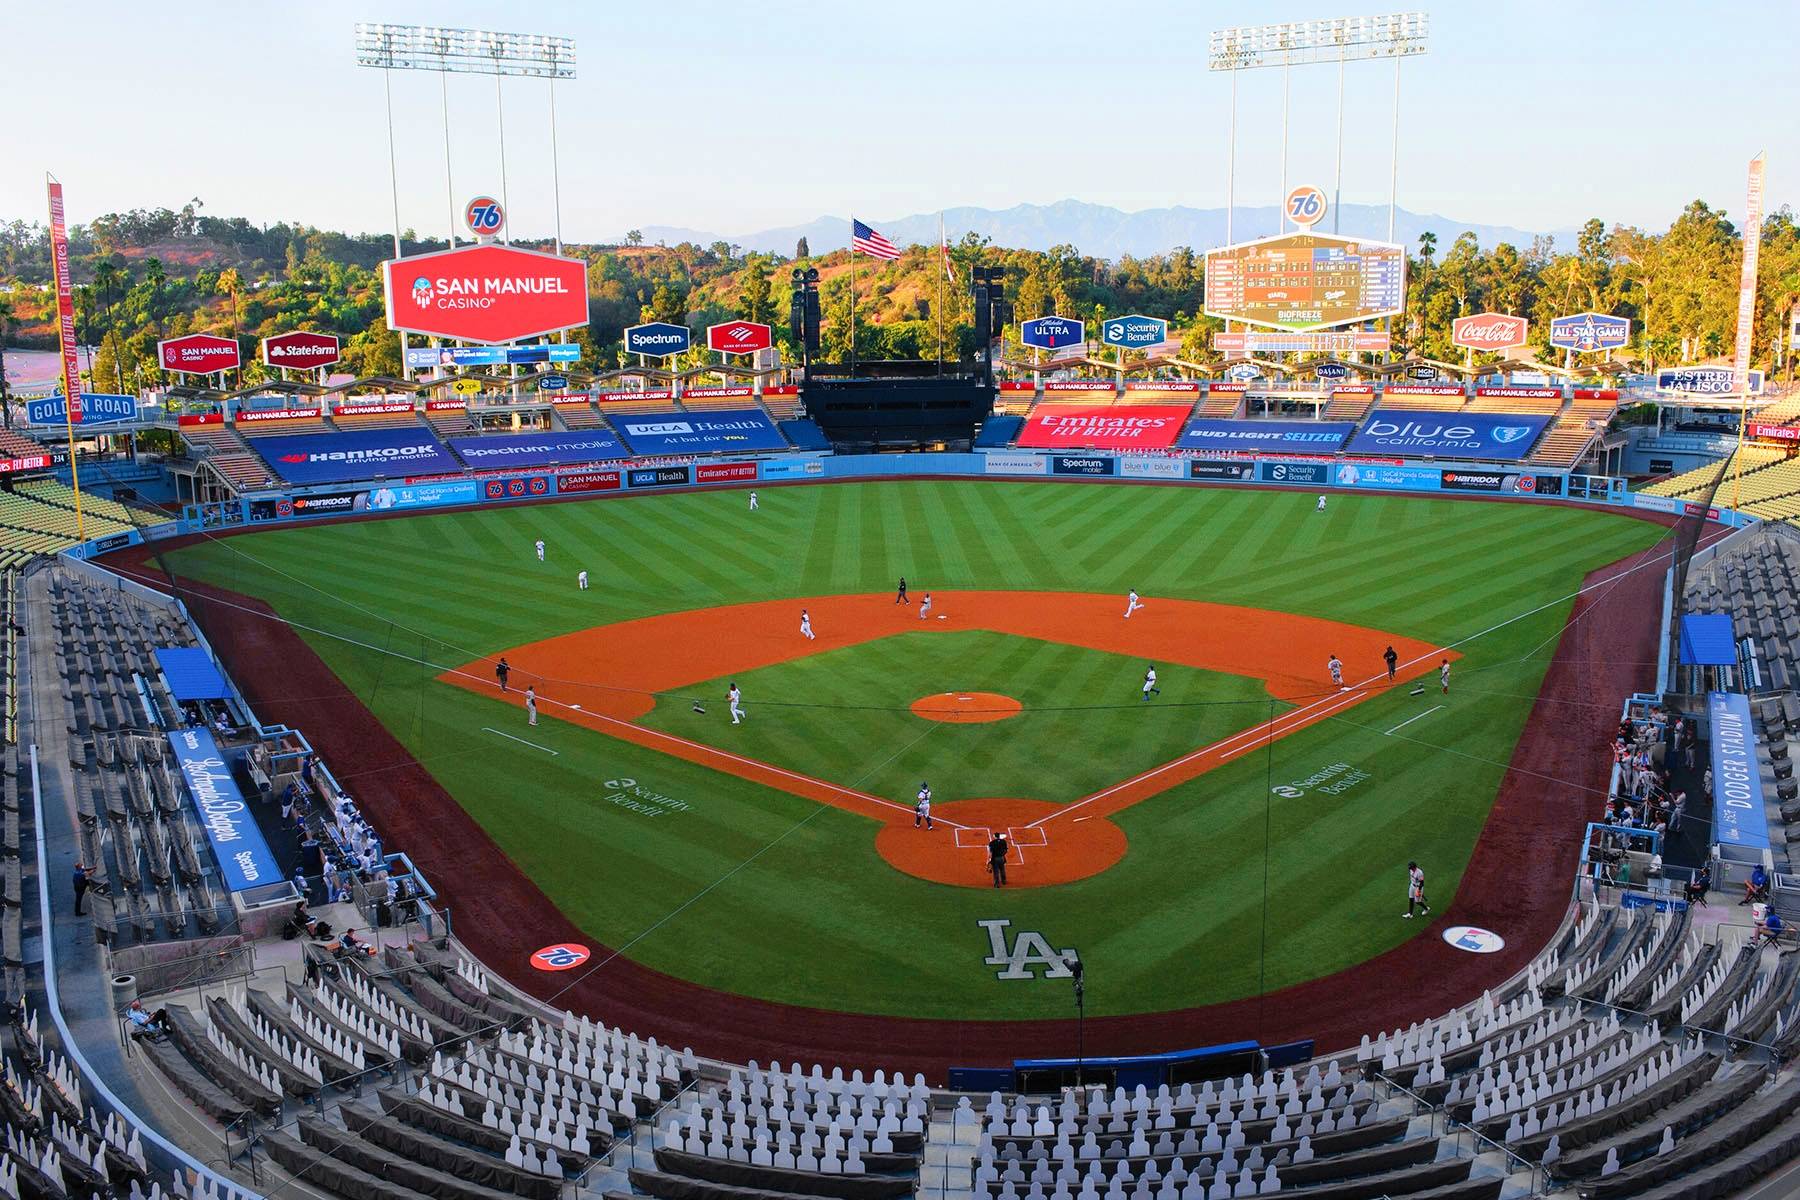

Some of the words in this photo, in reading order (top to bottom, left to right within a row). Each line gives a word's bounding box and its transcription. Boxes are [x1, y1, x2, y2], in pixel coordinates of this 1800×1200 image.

[1291, 193, 1319, 217] 76
[471, 204, 501, 229] 76
[1291, 236, 1314, 246] 7:14
[57, 244, 71, 296] Emirates
[435, 277, 479, 295] SAN
[484, 277, 569, 294] MANUEL
[1278, 310, 1323, 318] BIOFREEZE
[61, 315, 75, 343] BETTER
[1034, 326, 1069, 335] ULTRA
[1126, 323, 1161, 334] Security
[1596, 326, 1625, 337] GAME
[632, 333, 681, 346] Spectrum
[1127, 332, 1155, 342] Benefit
[64, 344, 77, 357] FLY
[1318, 367, 1344, 376] DASANI
[67, 361, 80, 413] Emirates
[1407, 387, 1433, 395] MANUEL
[1666, 381, 1733, 392] JALISCO
[1502, 389, 1528, 397] MANUEL
[34, 398, 89, 420] GOLDN
[94, 398, 131, 415] ROAD
[343, 406, 357, 414] SAN
[358, 405, 385, 413] MANUEL
[262, 411, 290, 420] MANUEL
[636, 424, 685, 434] UCLA
[695, 420, 765, 431] Health
[1040, 415, 1166, 428] Emirates
[1050, 427, 1079, 436] FLY
[1087, 427, 1143, 437] BETTER
[1364, 419, 1476, 438] blue
[1756, 425, 1795, 439] Emirates
[663, 436, 678, 444] At
[681, 435, 700, 443] bat
[703, 434, 720, 443] for
[1188, 430, 1227, 438] BUD
[1228, 431, 1283, 440] LIGHT
[1282, 431, 1343, 442] SELTZER
[1375, 436, 1481, 448] california
[462, 445, 550, 457] Spectrum
[556, 440, 612, 450] mobile
[345, 455, 387, 464] driving
[389, 451, 439, 461] emotion
[1062, 458, 1101, 468] Spectrum
[13, 459, 23, 470] FLY
[23, 457, 44, 469] BETTER
[1124, 462, 1142, 470] blue
[698, 470, 729, 479] Emirates
[738, 467, 755, 475] BETTER
[1288, 465, 1317, 475] Security
[568, 476, 585, 484] SAN
[585, 474, 618, 482] MANUEL
[635, 474, 654, 482] UCLA
[658, 472, 685, 481] Health
[1288, 473, 1313, 481] Benefit
[490, 484, 501, 493] 76
[511, 483, 523, 492] 76
[533, 481, 544, 490] 76
[1522, 480, 1533, 488] 76
[278, 502, 292, 512] 76
[1719, 712, 1747, 755] STADIUM
[1722, 759, 1753, 809] DODGER
[233, 850, 260, 881] Spectrum
[977, 918, 1082, 980] LA
[535, 946, 587, 967] 76
